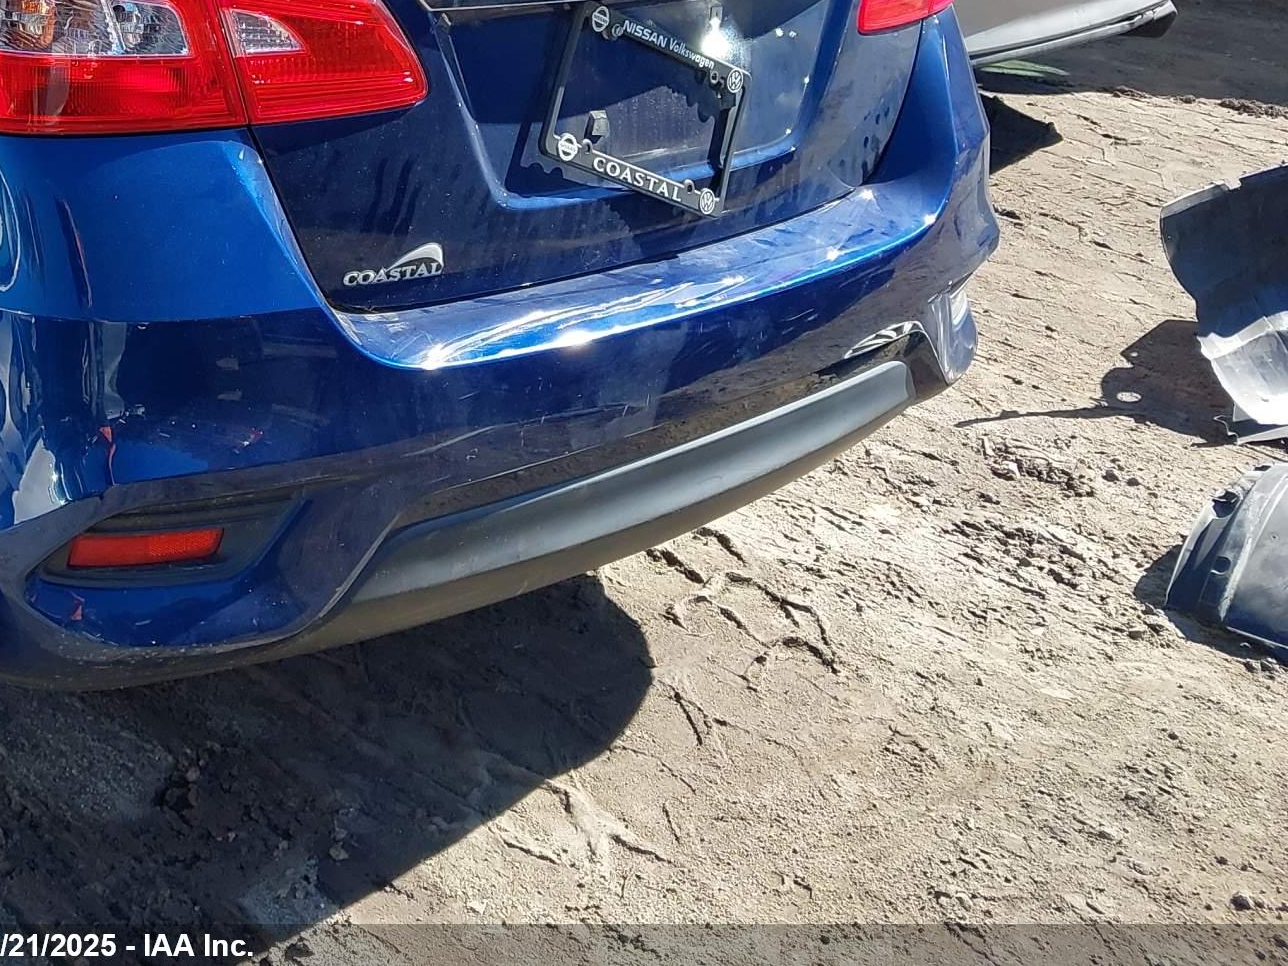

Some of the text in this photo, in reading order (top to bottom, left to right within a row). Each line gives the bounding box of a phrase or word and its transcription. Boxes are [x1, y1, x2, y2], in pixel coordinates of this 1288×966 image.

[622, 19, 715, 70] NISSAN Volkswagen
[592, 156, 682, 202] COASTAL
[342, 263, 443, 286] COASTAL
